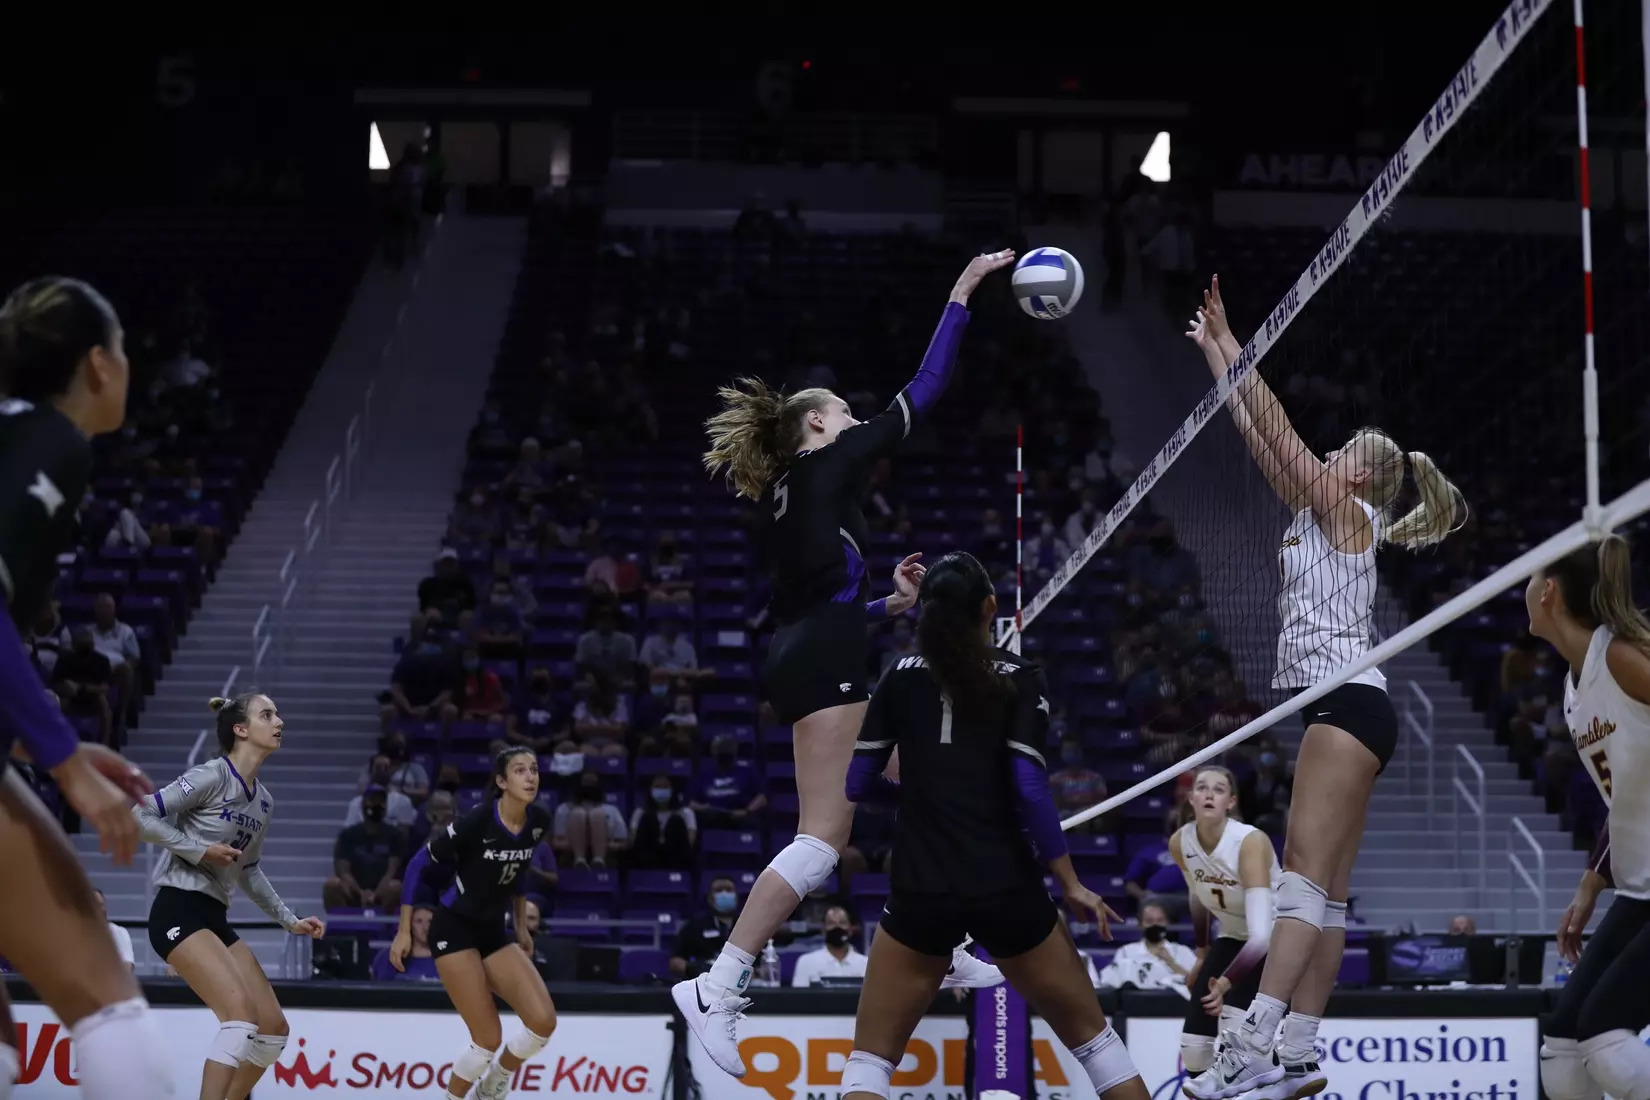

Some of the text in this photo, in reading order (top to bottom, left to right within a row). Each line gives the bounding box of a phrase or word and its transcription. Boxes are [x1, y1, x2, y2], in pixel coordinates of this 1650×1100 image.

[157, 56, 196, 108] 5
[1435, 57, 1477, 131] K-STATE
[1372, 147, 1408, 210] K-STATE
[1319, 219, 1350, 277] K-STATE
[1272, 282, 1299, 332] K-STATE
[773, 470, 788, 521] 5
[940, 691, 953, 744] 1
[498, 862, 520, 885] 15
[1211, 889, 1226, 909] 7
[993, 987, 1008, 1079] sports imports
[1314, 1025, 1509, 1063] scension
